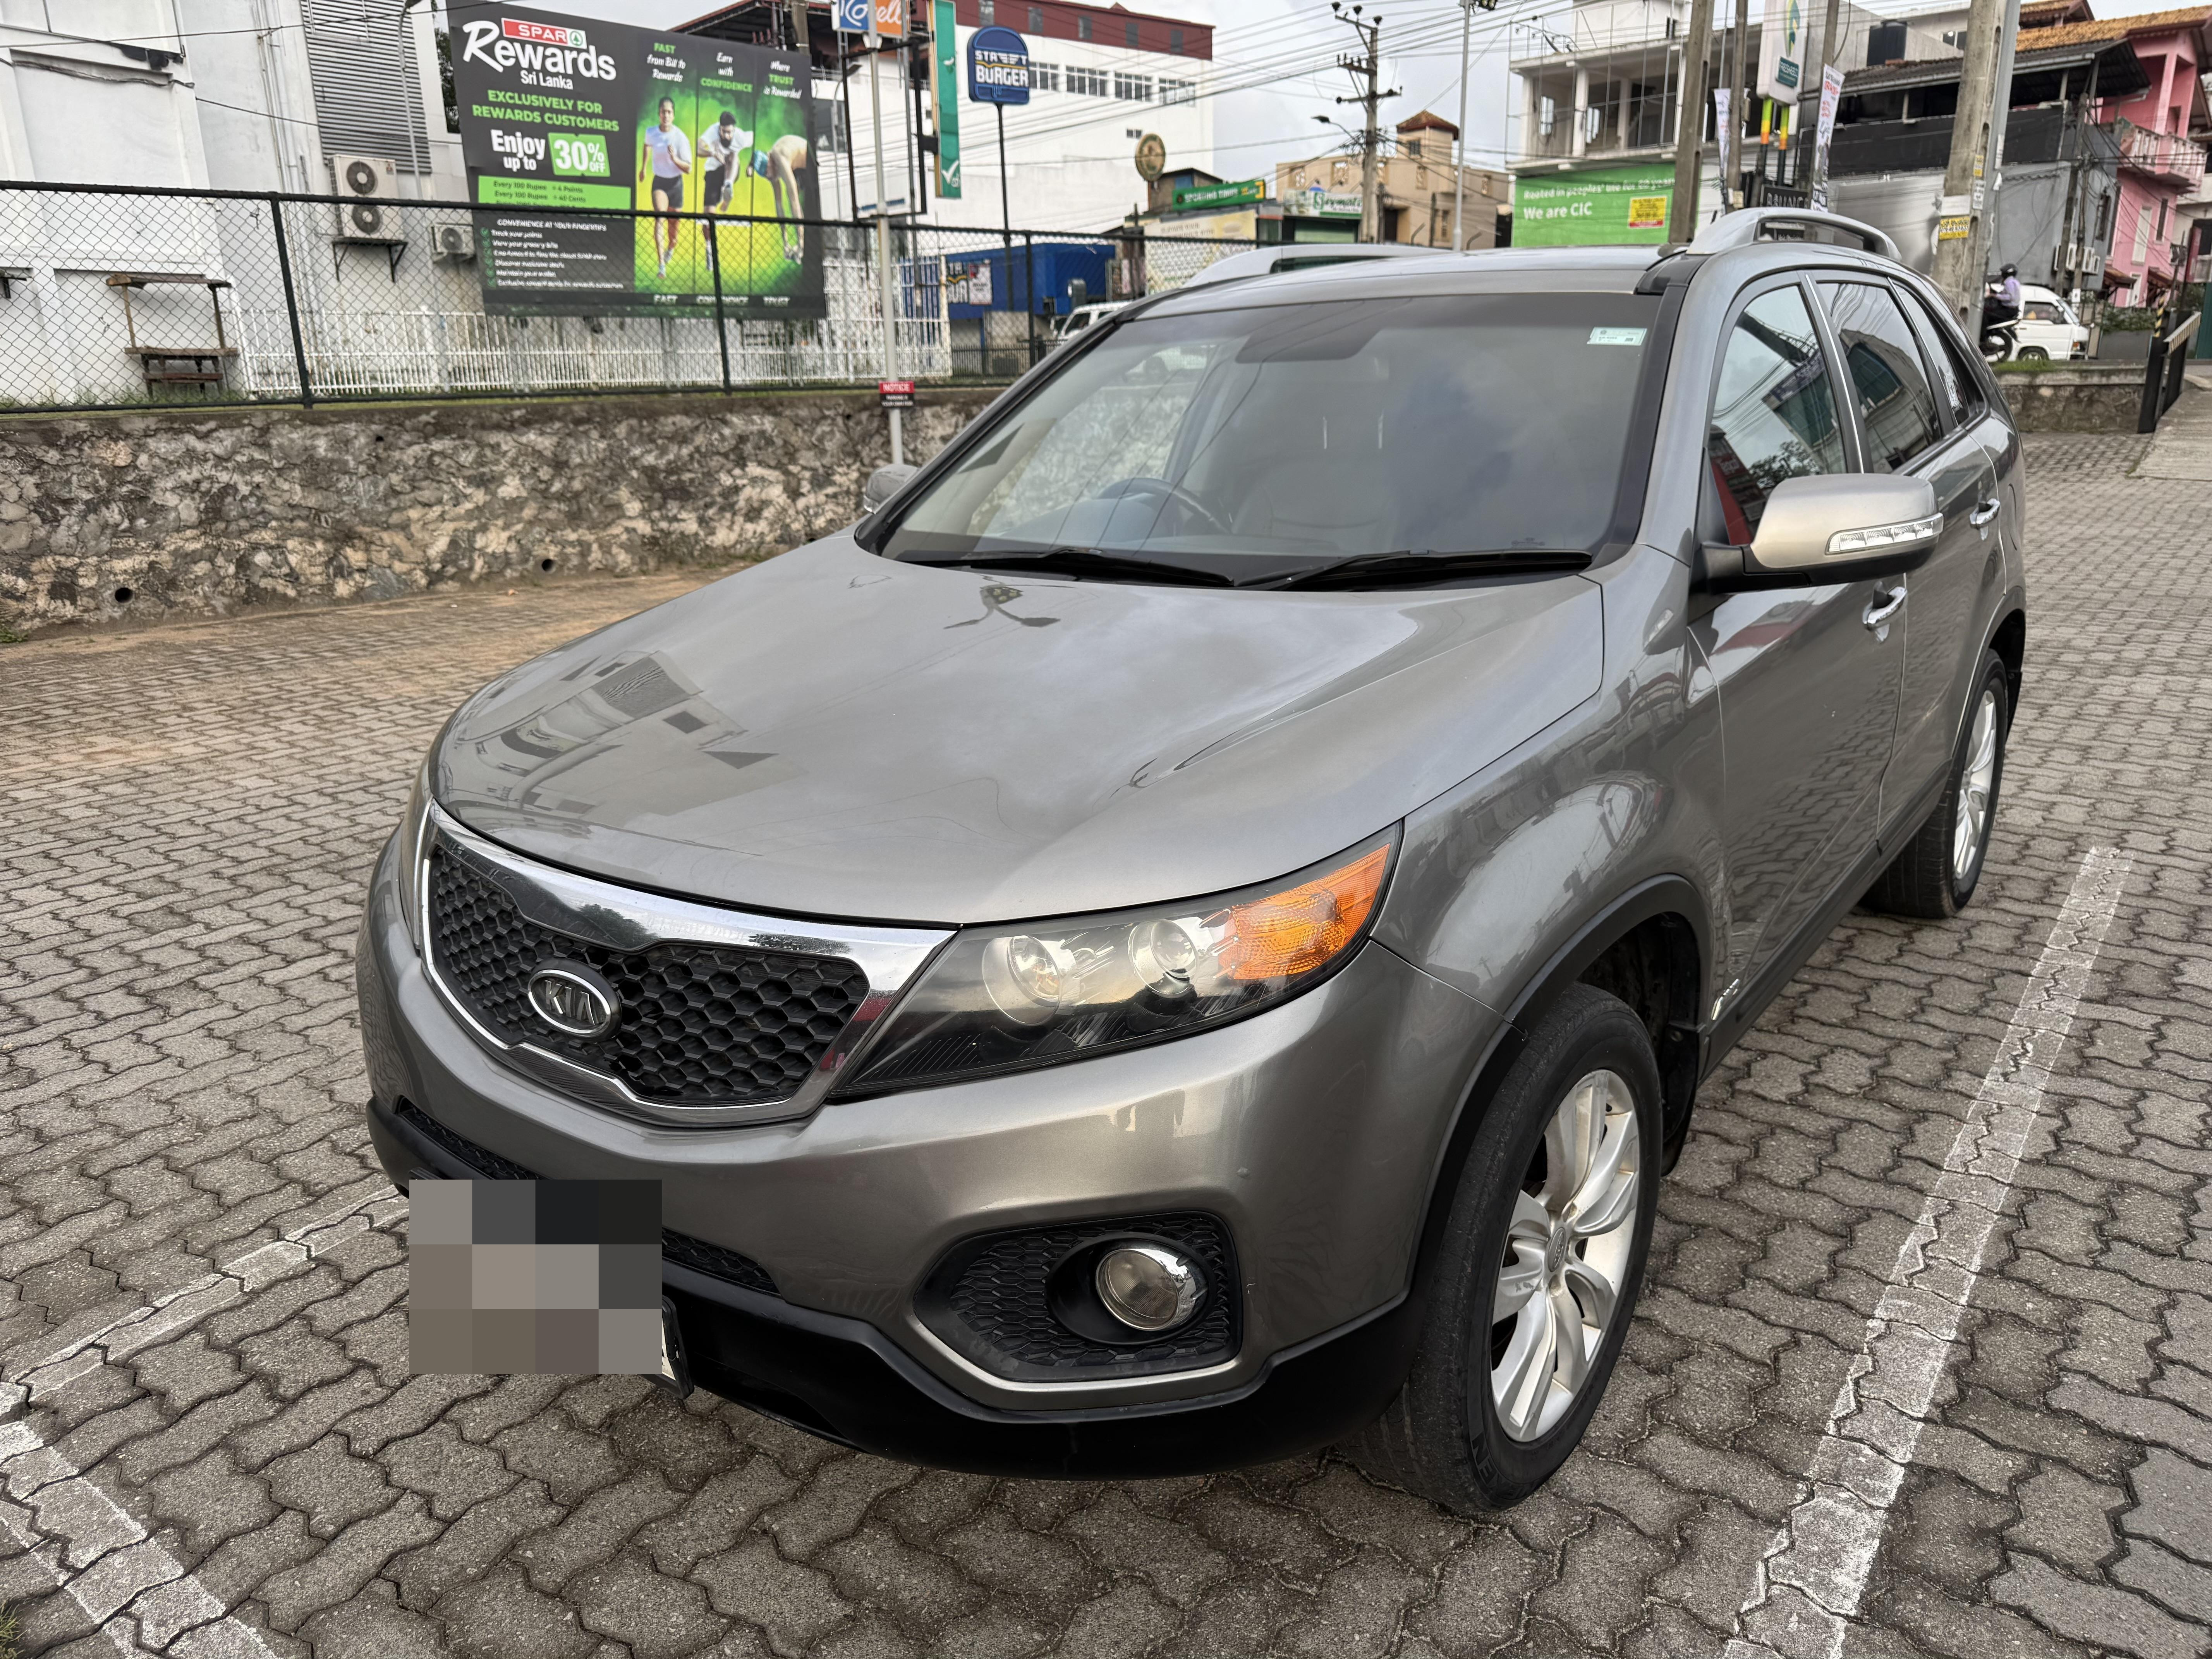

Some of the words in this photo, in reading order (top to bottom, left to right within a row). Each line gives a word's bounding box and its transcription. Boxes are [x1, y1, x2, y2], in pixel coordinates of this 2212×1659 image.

[518, 24, 568, 42] SPAR
[462, 20, 617, 81] Rewards
[654, 43, 676, 54] FAST
[520, 70, 537, 85] Sri
[539, 72, 573, 90] Lanka
[701, 77, 753, 93] CONFIDENCE
[768, 74, 795, 86] TRUST
[975, 66, 1029, 87] BURGER
[488, 89, 574, 111] EXCLUSIVELY
[577, 100, 603, 114] FOR
[472, 105, 542, 123] REWARDS
[544, 113, 620, 132] CUSTOMERS
[490, 129, 546, 160] Enjoy
[503, 156, 520, 172] up
[523, 156, 537, 171] to
[589, 161, 606, 174] OFF
[1523, 206, 1543, 220] We
[1546, 206, 1567, 219] are
[1570, 201, 1593, 217] CIC
[545, 979, 597, 1025] KIA
